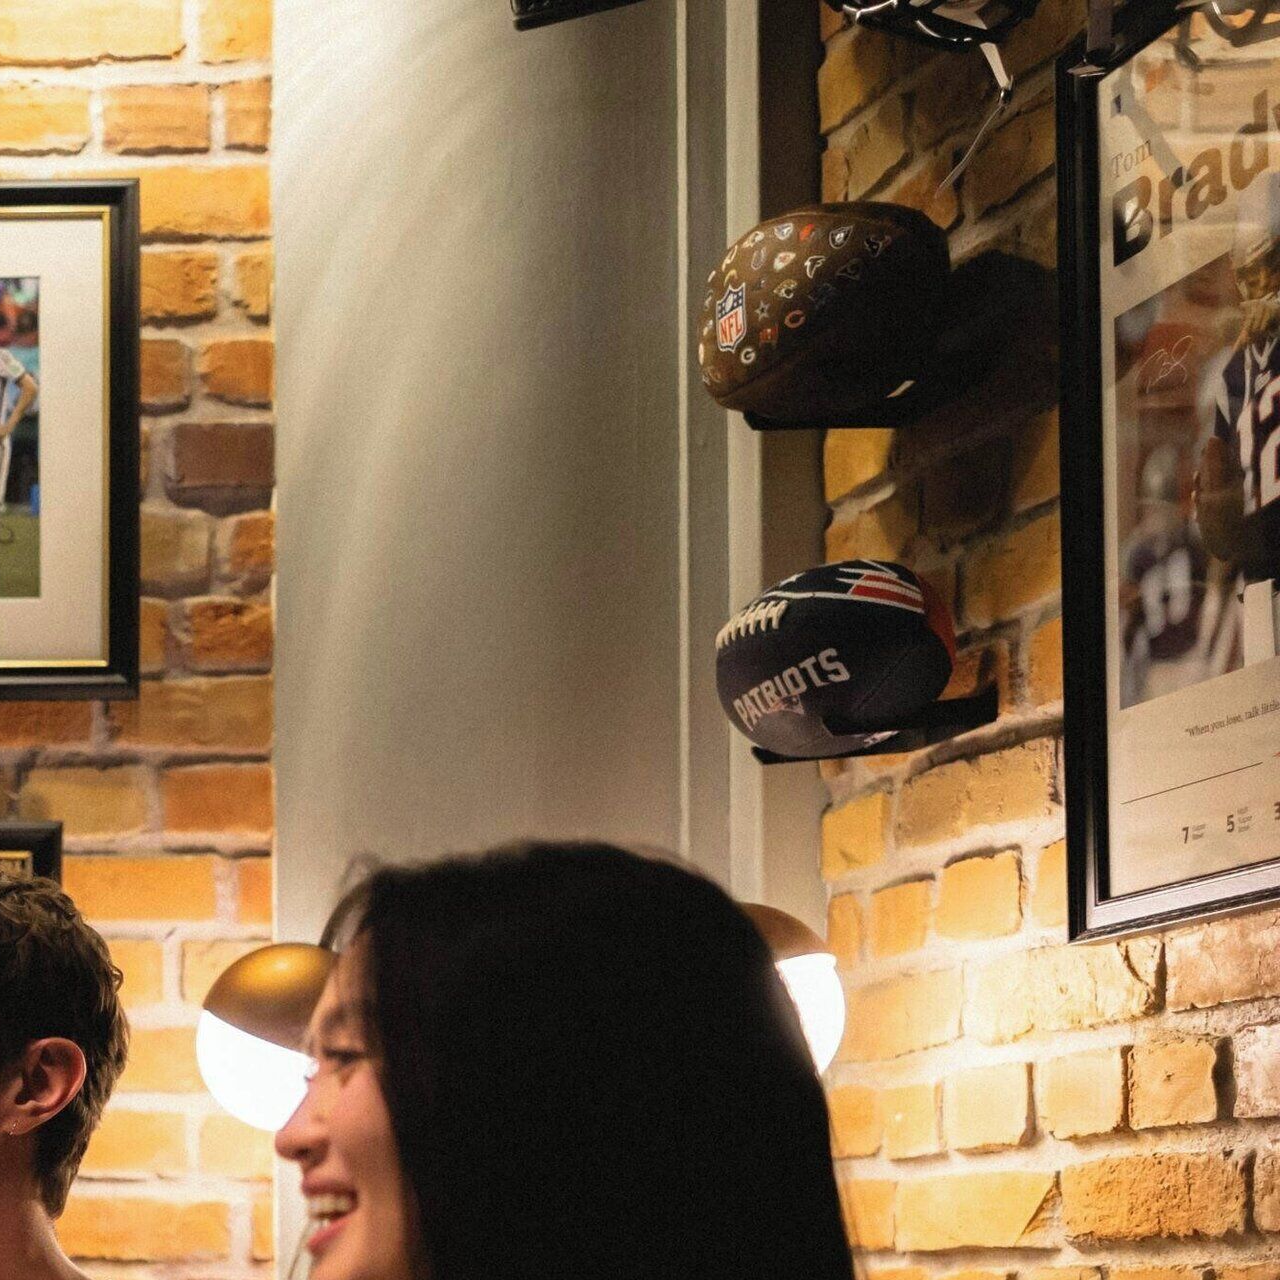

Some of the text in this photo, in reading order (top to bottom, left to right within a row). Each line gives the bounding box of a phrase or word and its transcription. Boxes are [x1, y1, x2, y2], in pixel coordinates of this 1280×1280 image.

[1111, 138, 1153, 178] Tom
[1112, 89, 1280, 267] Brad
[719, 314, 744, 344] NFL
[733, 647, 851, 731] PATRIOTS
[1182, 826, 1191, 844] 7
[1226, 813, 1236, 833] 5
